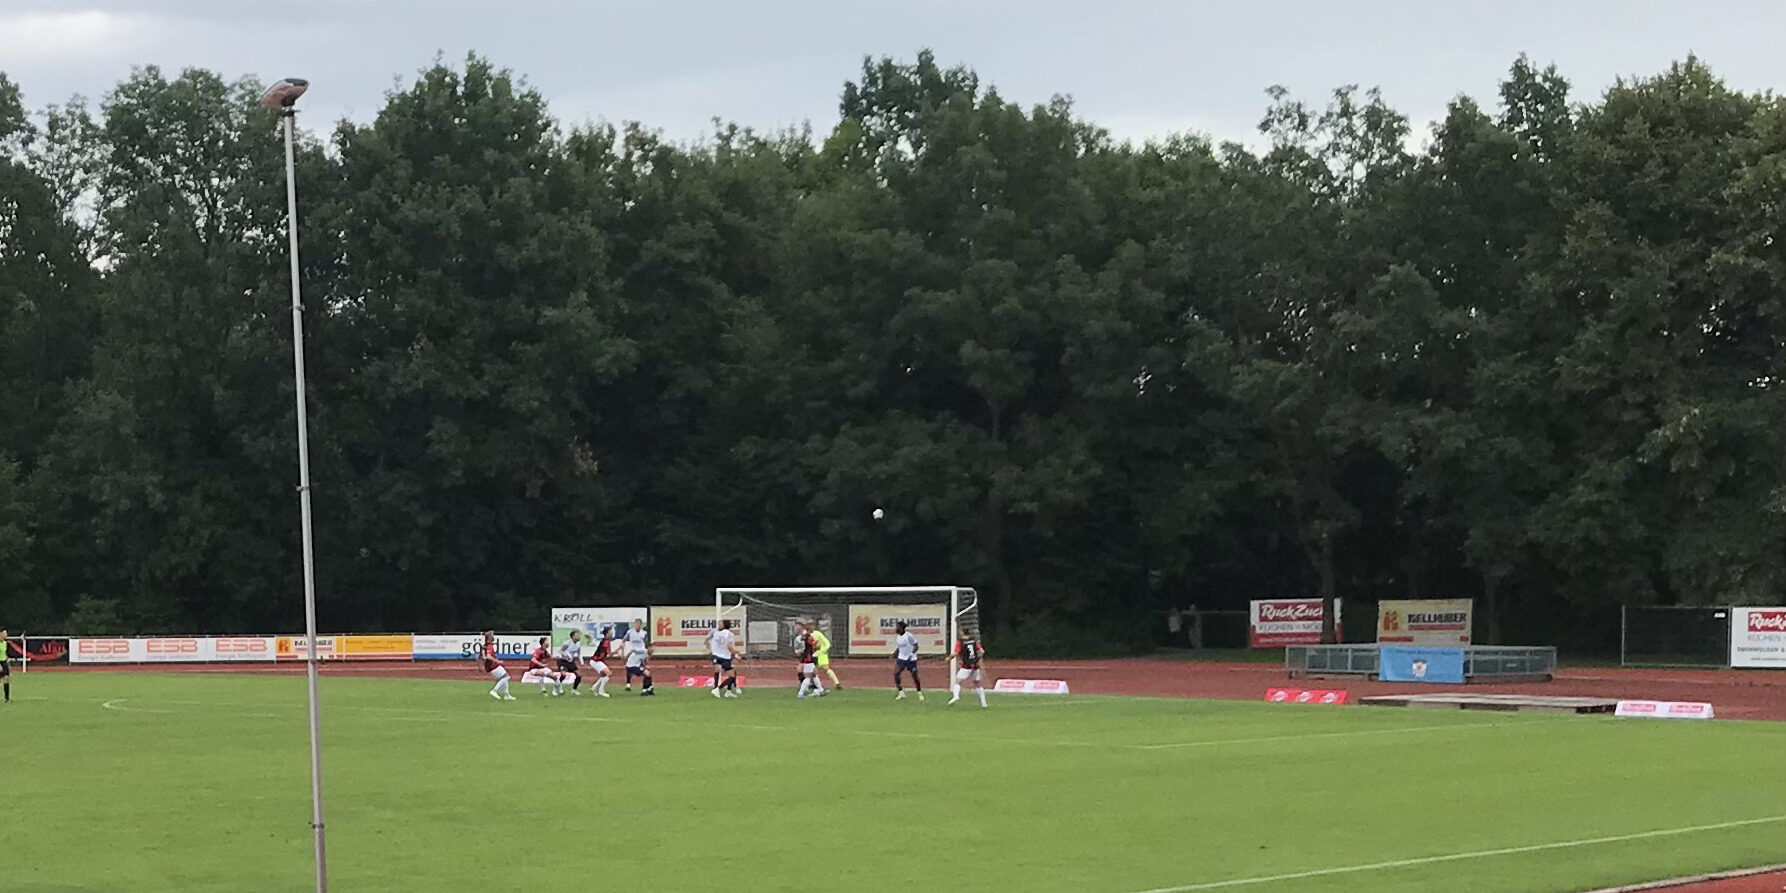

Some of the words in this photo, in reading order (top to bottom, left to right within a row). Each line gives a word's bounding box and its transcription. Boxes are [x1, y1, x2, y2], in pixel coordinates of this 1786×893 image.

[1261, 604, 1323, 619] RuckZuc
[681, 619, 741, 629] KELLHER
[1749, 613, 1786, 630] Ruck
[79, 640, 129, 653] ESB
[147, 640, 198, 653] ESB
[216, 639, 267, 652] ESB
